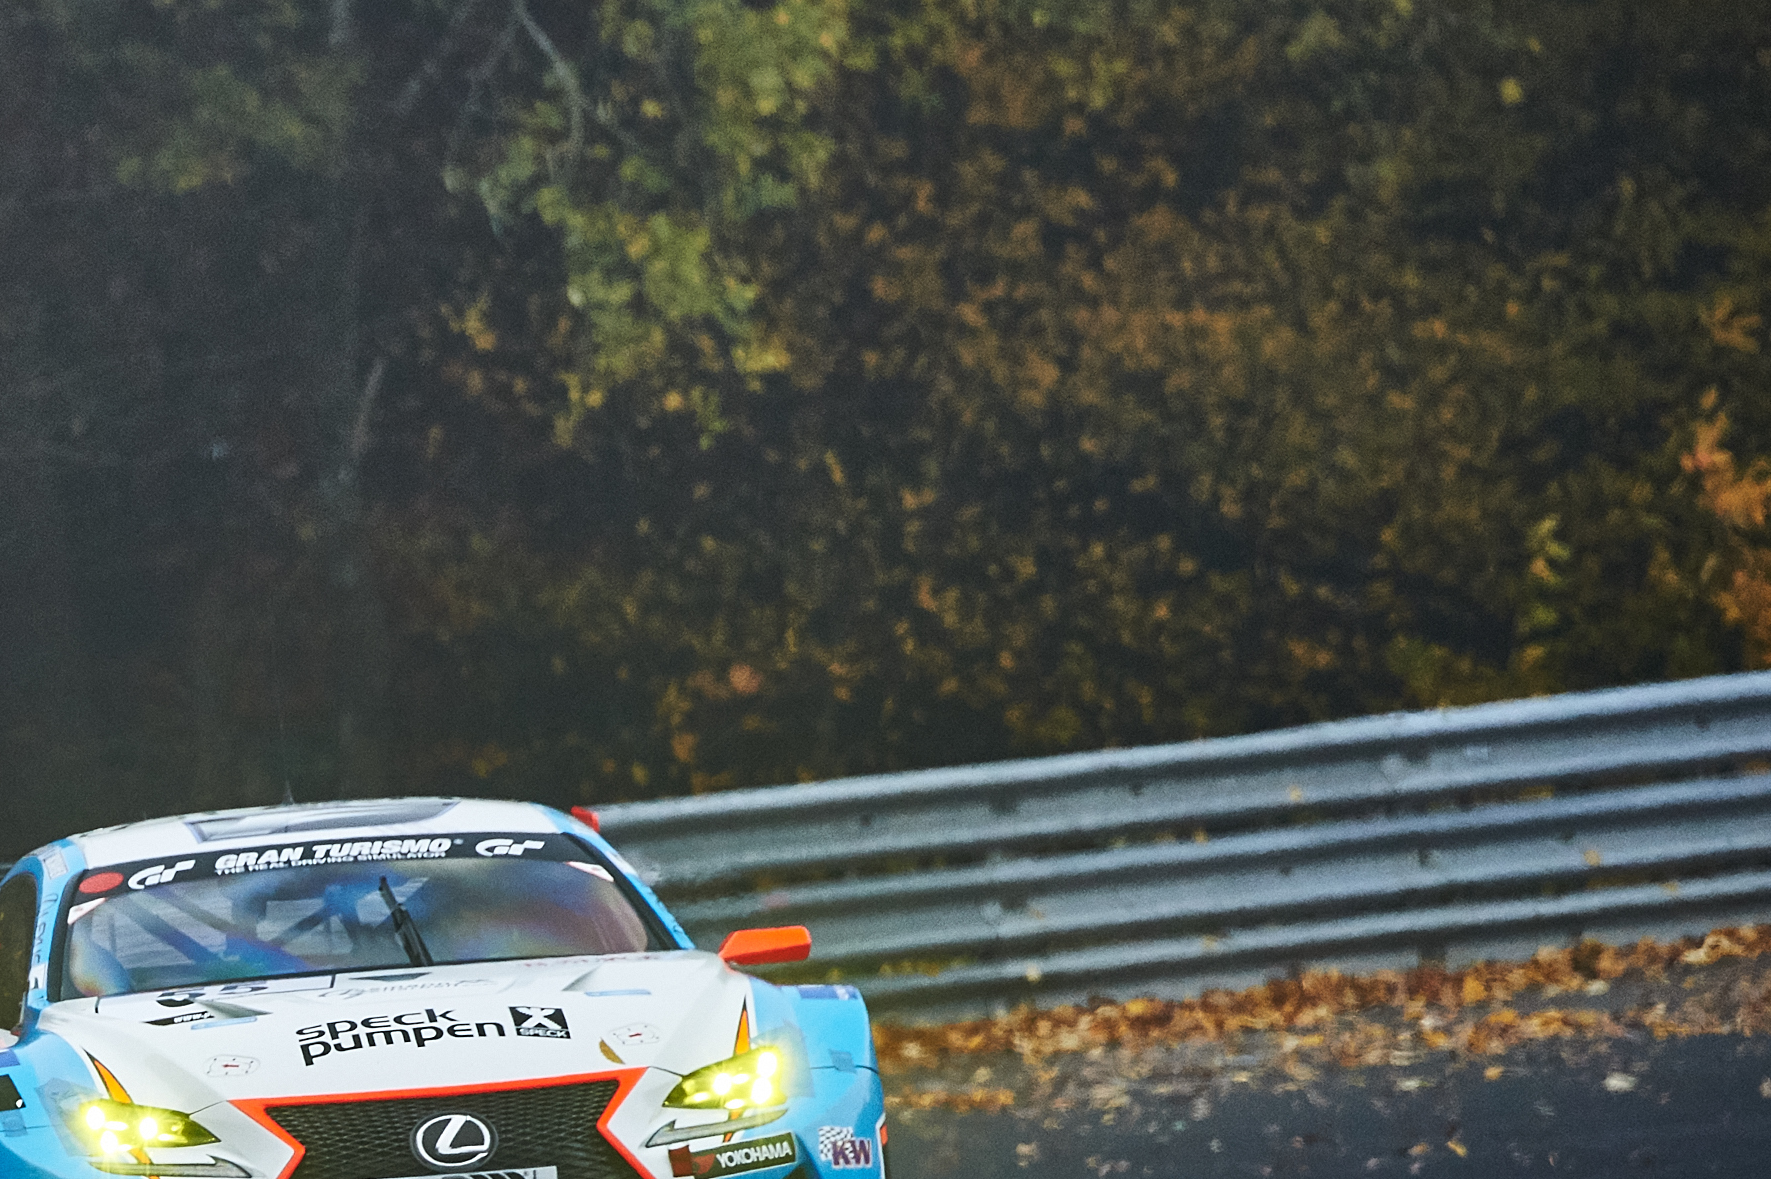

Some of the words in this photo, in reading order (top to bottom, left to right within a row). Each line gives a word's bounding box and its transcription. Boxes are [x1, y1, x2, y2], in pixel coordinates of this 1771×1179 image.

[215, 846, 304, 870] GRAN
[312, 838, 452, 858] TURISMO
[300, 1022, 506, 1066] pumpen
[519, 1027, 568, 1039] SPECK
[716, 1141, 793, 1169] YOKOHAMA
[831, 1138, 872, 1168] KW
